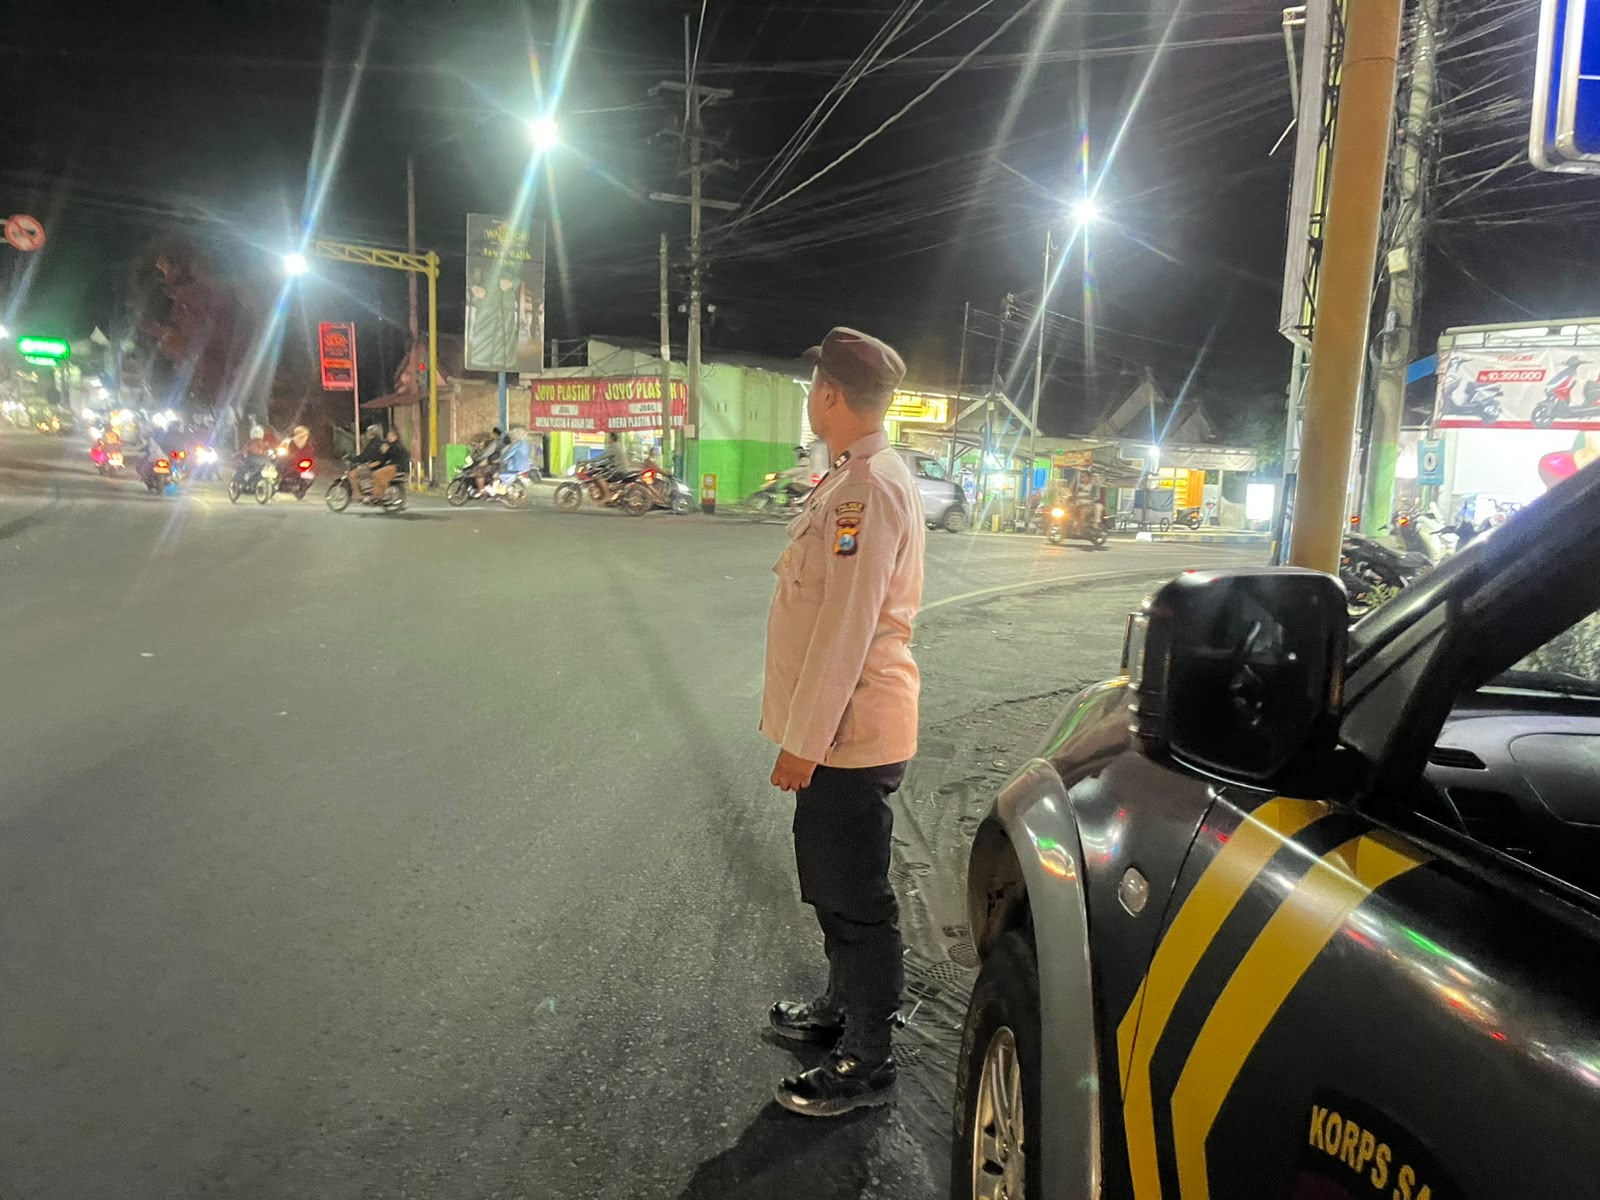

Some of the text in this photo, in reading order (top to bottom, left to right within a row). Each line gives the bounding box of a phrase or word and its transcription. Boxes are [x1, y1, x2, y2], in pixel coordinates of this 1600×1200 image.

[535, 384, 555, 401] JOYO
[605, 382, 633, 401] JOYO
[1309, 1104, 1392, 1189] KORPS
